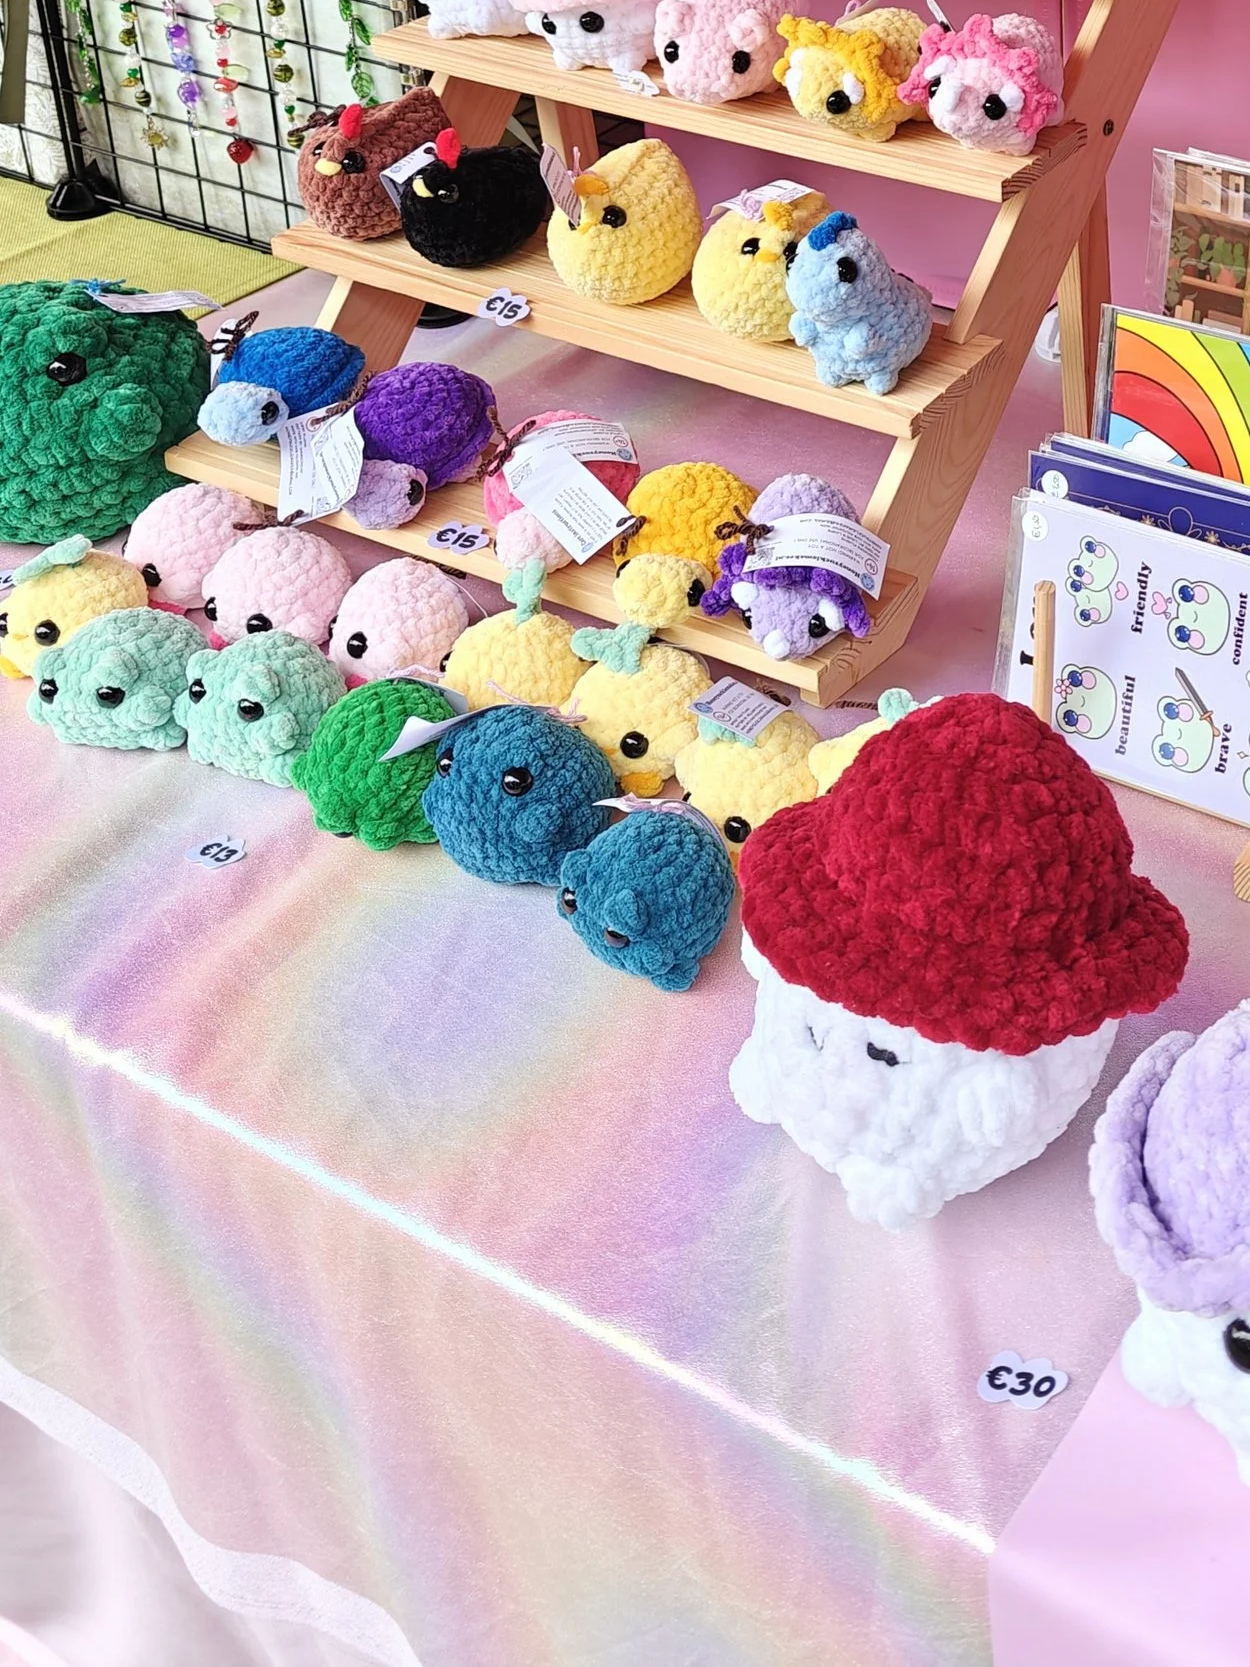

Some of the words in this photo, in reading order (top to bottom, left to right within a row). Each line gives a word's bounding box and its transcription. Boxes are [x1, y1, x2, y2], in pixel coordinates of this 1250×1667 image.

[486, 296, 523, 319] €15
[436, 528, 480, 549] €15
[1131, 561, 1152, 634] friendly
[1231, 592, 1248, 666] confident
[1115, 675, 1136, 756] beautiful
[1215, 723, 1232, 774] brave
[200, 842, 239, 863] €13
[986, 1365, 1056, 1398] €30
